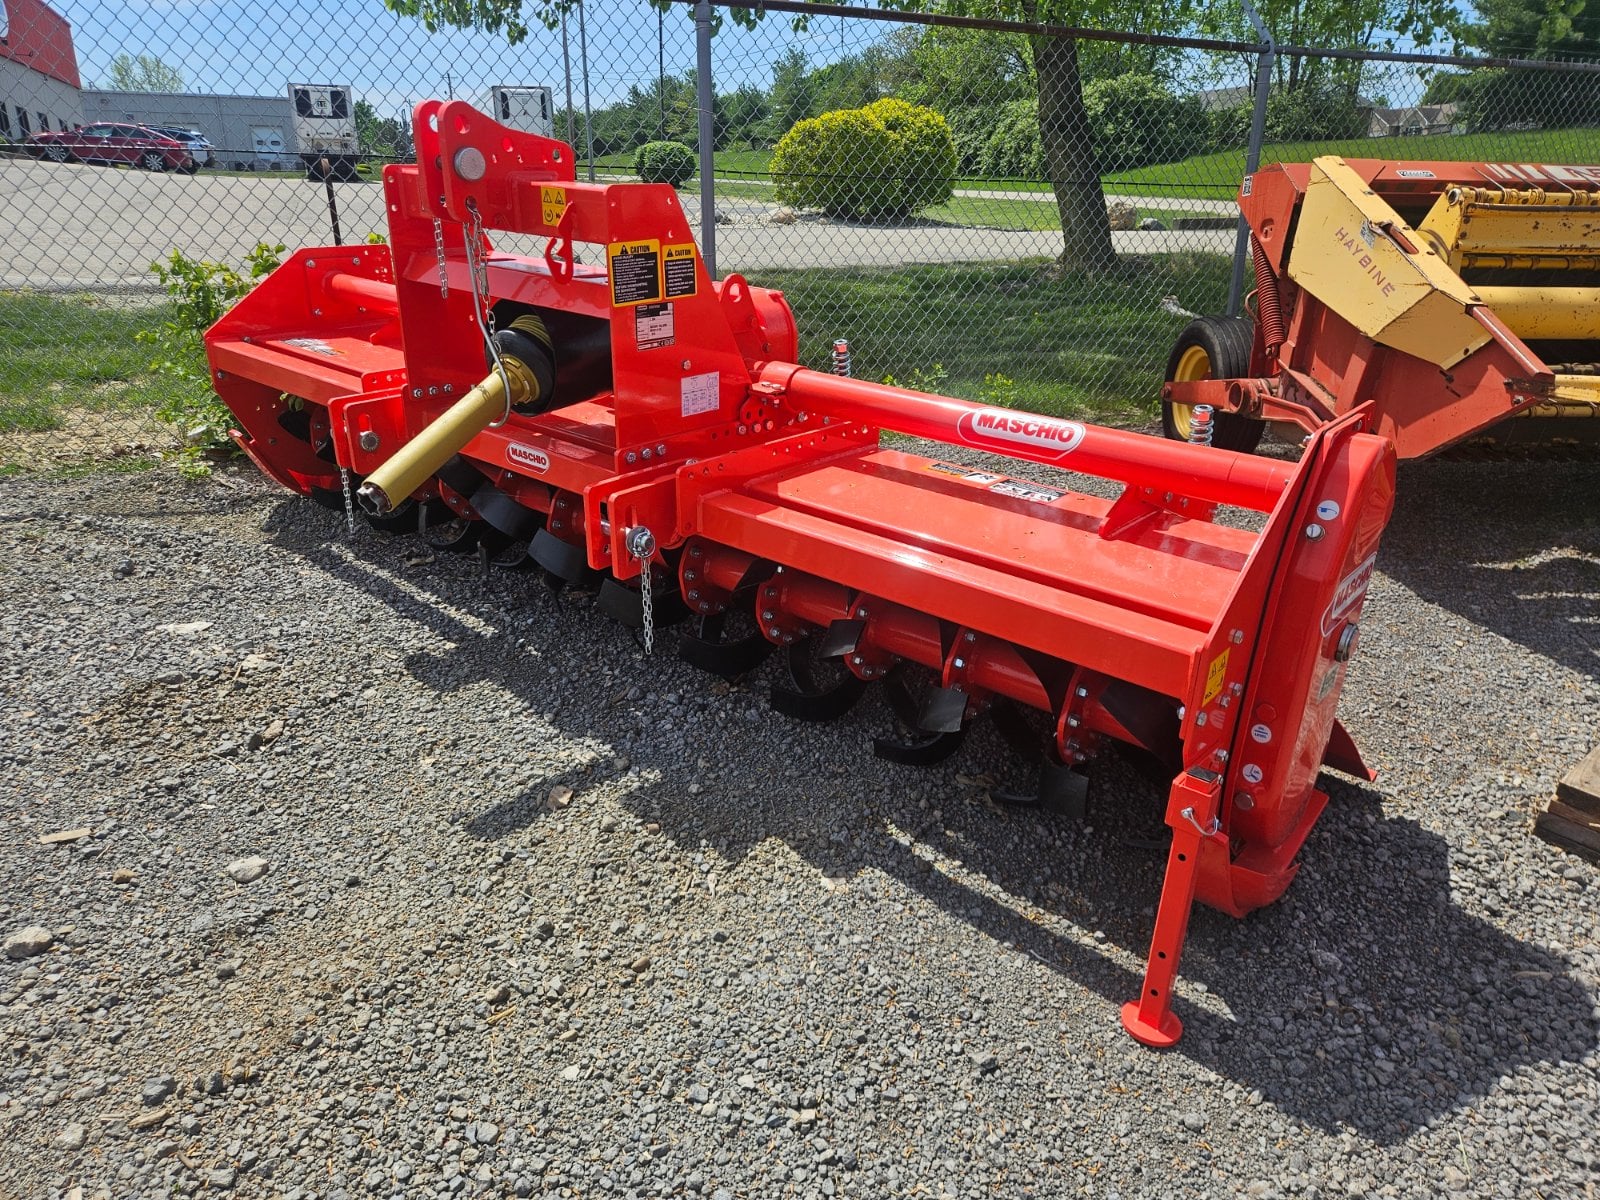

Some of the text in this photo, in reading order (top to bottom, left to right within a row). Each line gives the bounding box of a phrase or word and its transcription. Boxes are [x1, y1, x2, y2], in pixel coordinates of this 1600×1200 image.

[630, 244, 650, 254] CAUTION
[675, 249, 691, 257] CAUTION
[1335, 227, 1396, 298] HAYBINE
[976, 413, 1076, 443] MASCHIO
[511, 446, 547, 466] MASCHIO
